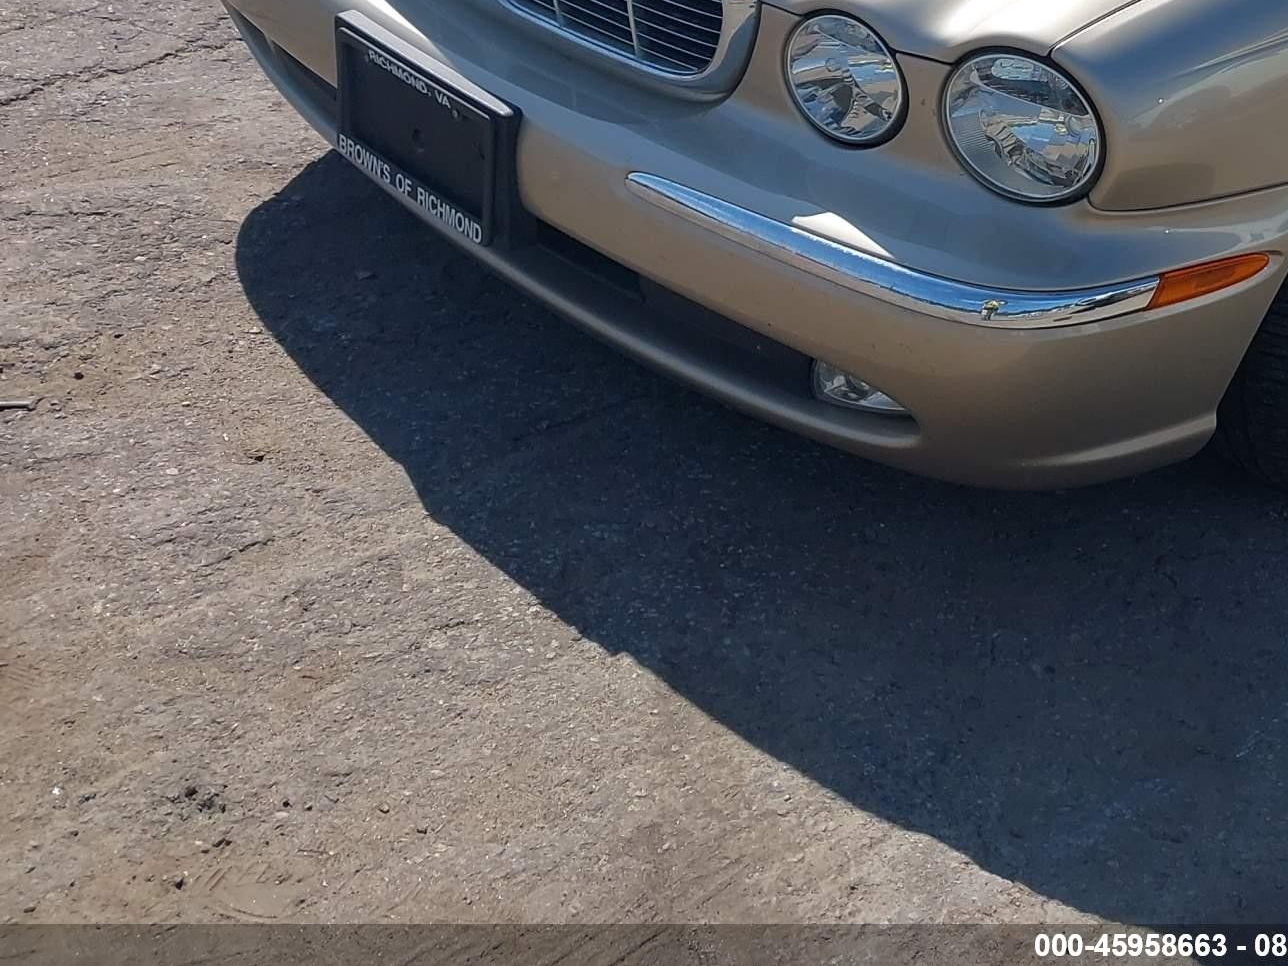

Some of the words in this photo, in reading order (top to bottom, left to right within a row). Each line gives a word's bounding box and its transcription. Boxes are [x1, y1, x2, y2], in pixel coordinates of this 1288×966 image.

[368, 49, 432, 97] RICHMOND,
[434, 89, 451, 109] VA
[338, 133, 391, 184] BROWN'S
[395, 173, 413, 195] OF
[416, 186, 483, 244] RICHMOND
